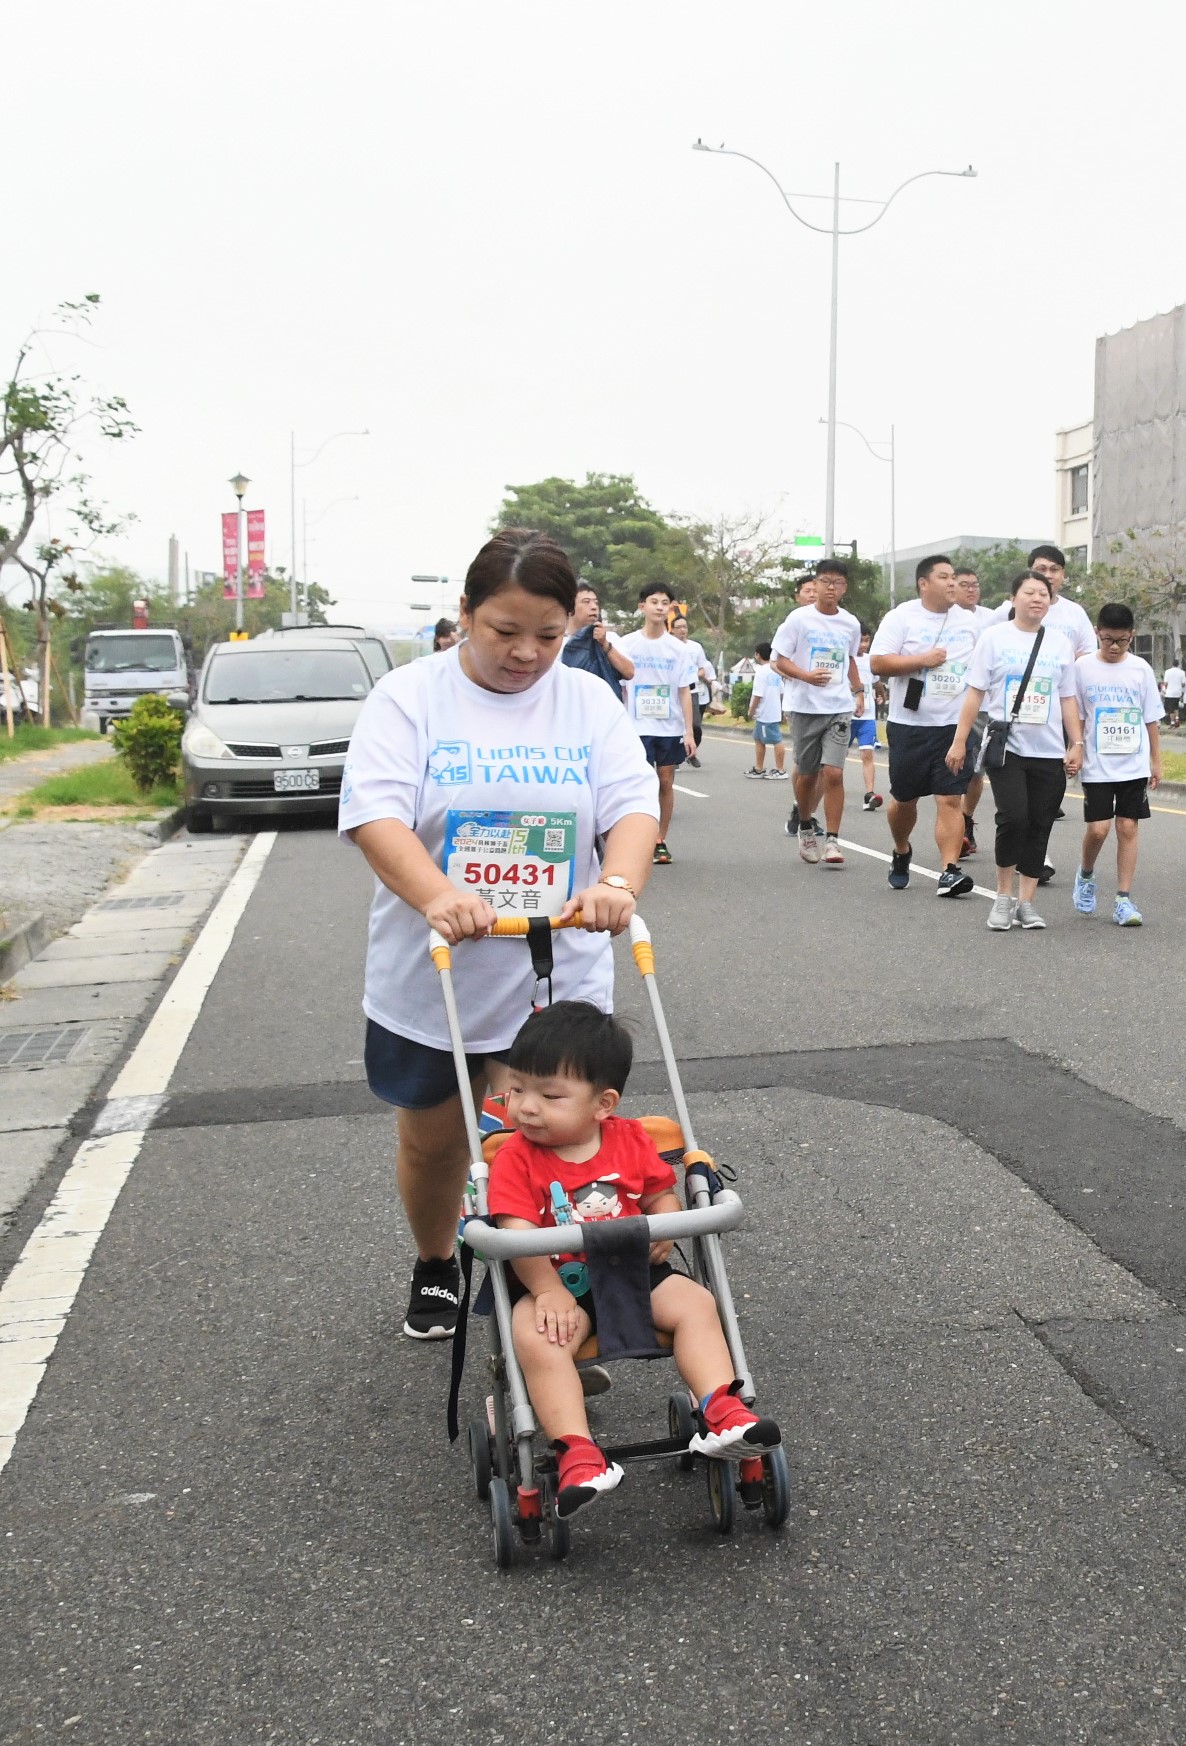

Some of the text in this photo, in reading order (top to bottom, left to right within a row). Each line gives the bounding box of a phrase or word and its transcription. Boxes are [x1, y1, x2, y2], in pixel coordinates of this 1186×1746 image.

[815, 661, 840, 669] 30206
[932, 674, 961, 683] 30203
[1012, 694, 1046, 704] 5155
[1103, 726, 1136, 735] 30161
[477, 745, 546, 760] LIONS
[464, 862, 555, 886] 50431
[421, 1286, 458, 1305] adidas
